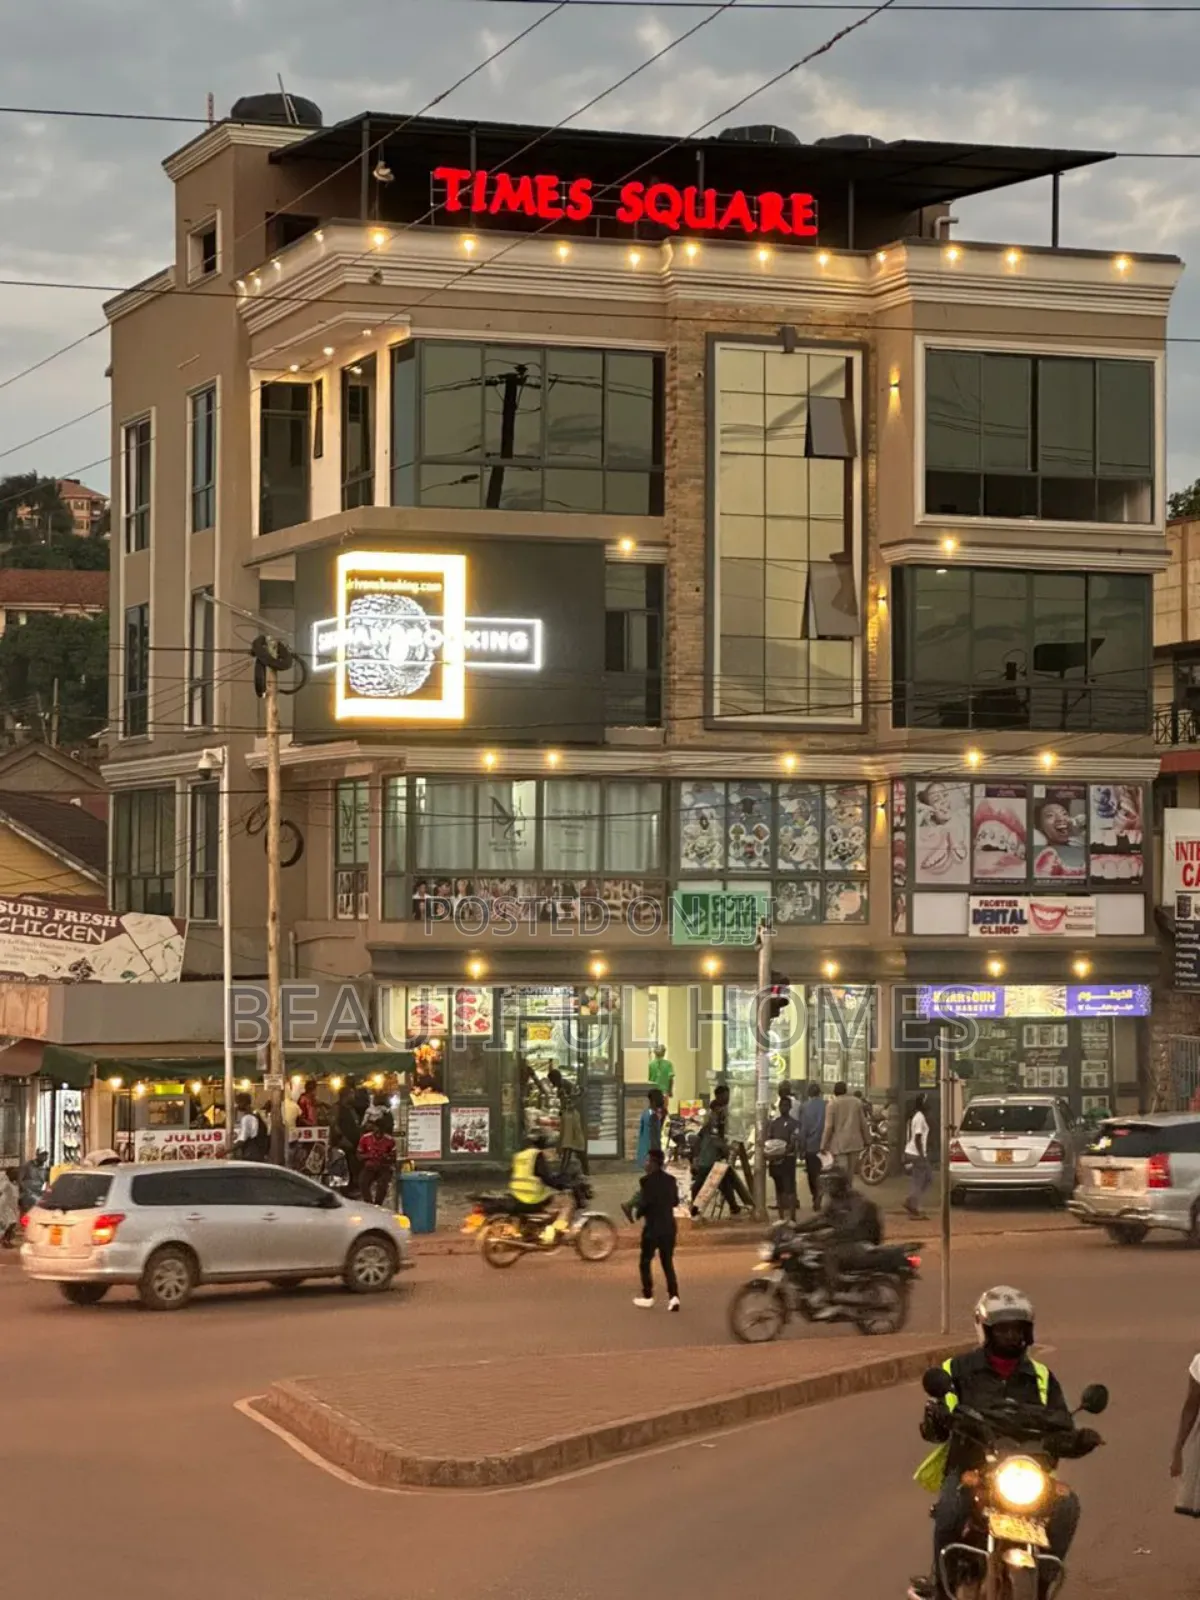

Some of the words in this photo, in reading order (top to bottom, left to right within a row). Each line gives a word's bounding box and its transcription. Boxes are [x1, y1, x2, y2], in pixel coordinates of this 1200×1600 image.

[432, 166, 593, 221] TIMES
[616, 181, 819, 236] SQUARE
[53, 909, 118, 928] FRESH
[972, 908, 1027, 925] DENTAL
[0, 917, 106, 943] CHICKEN
[979, 926, 1019, 935] CLINIC
[163, 1131, 223, 1143] JULIUS
